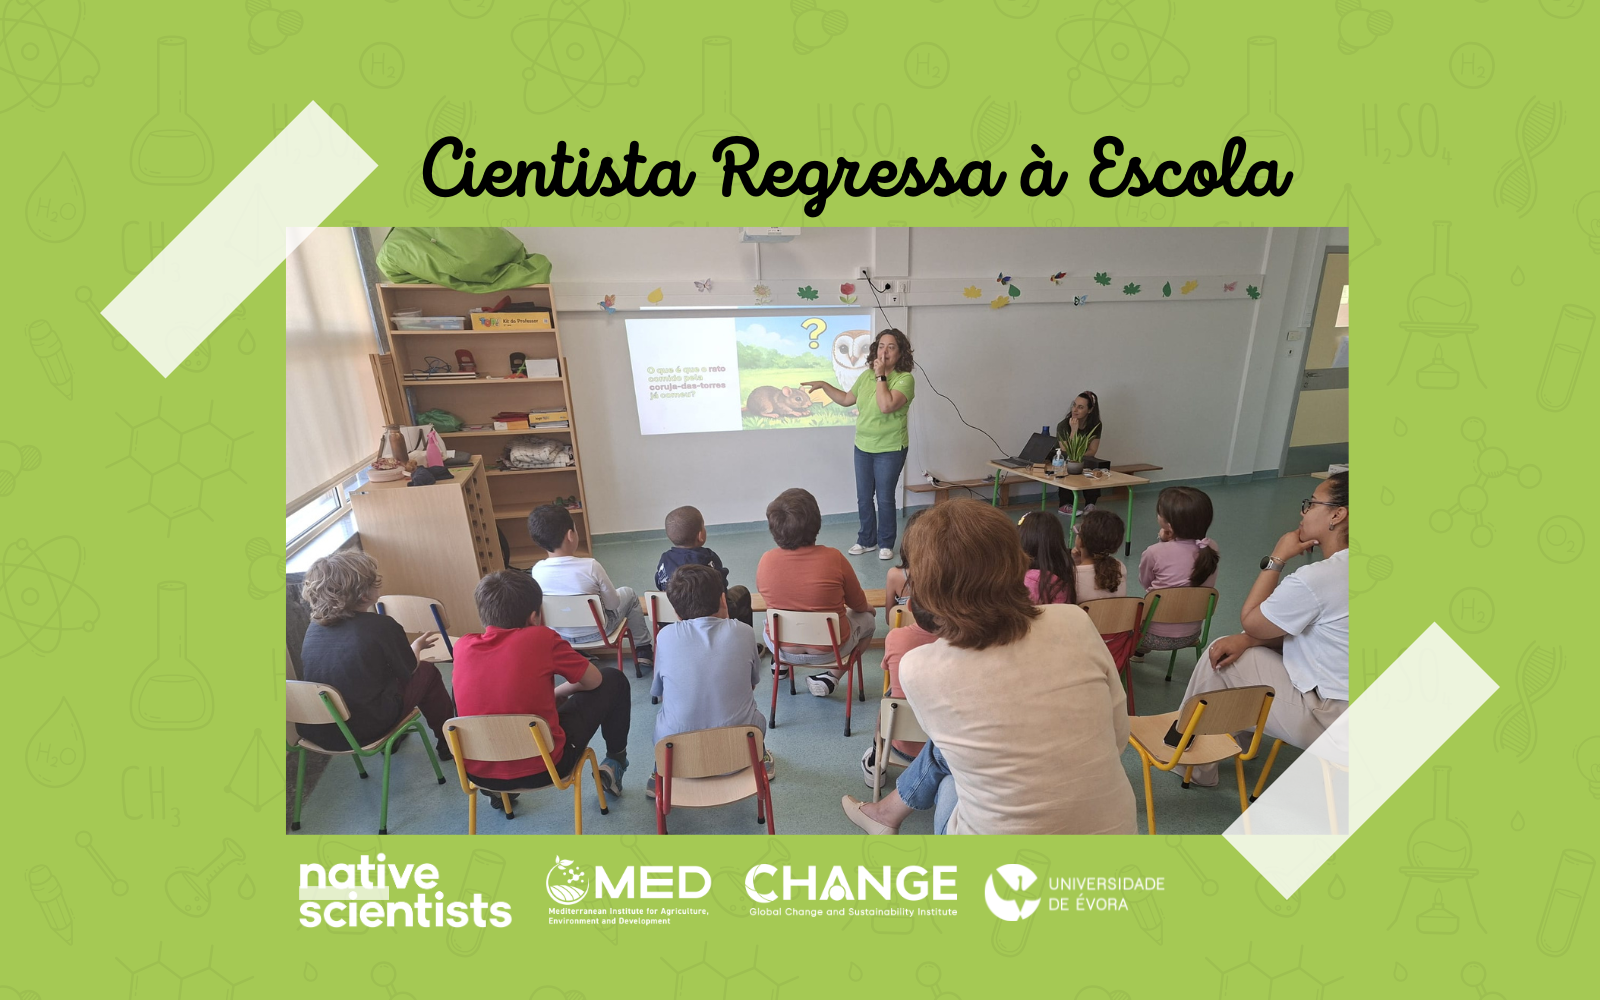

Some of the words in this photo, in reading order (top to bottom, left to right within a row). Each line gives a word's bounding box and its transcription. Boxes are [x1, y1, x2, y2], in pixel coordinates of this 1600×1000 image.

[647, 366, 655, 374] O
[657, 367, 674, 375] que
[684, 374, 703, 382] pela
[649, 383, 726, 391] coruja-das-torres
[650, 392, 659, 400] já
